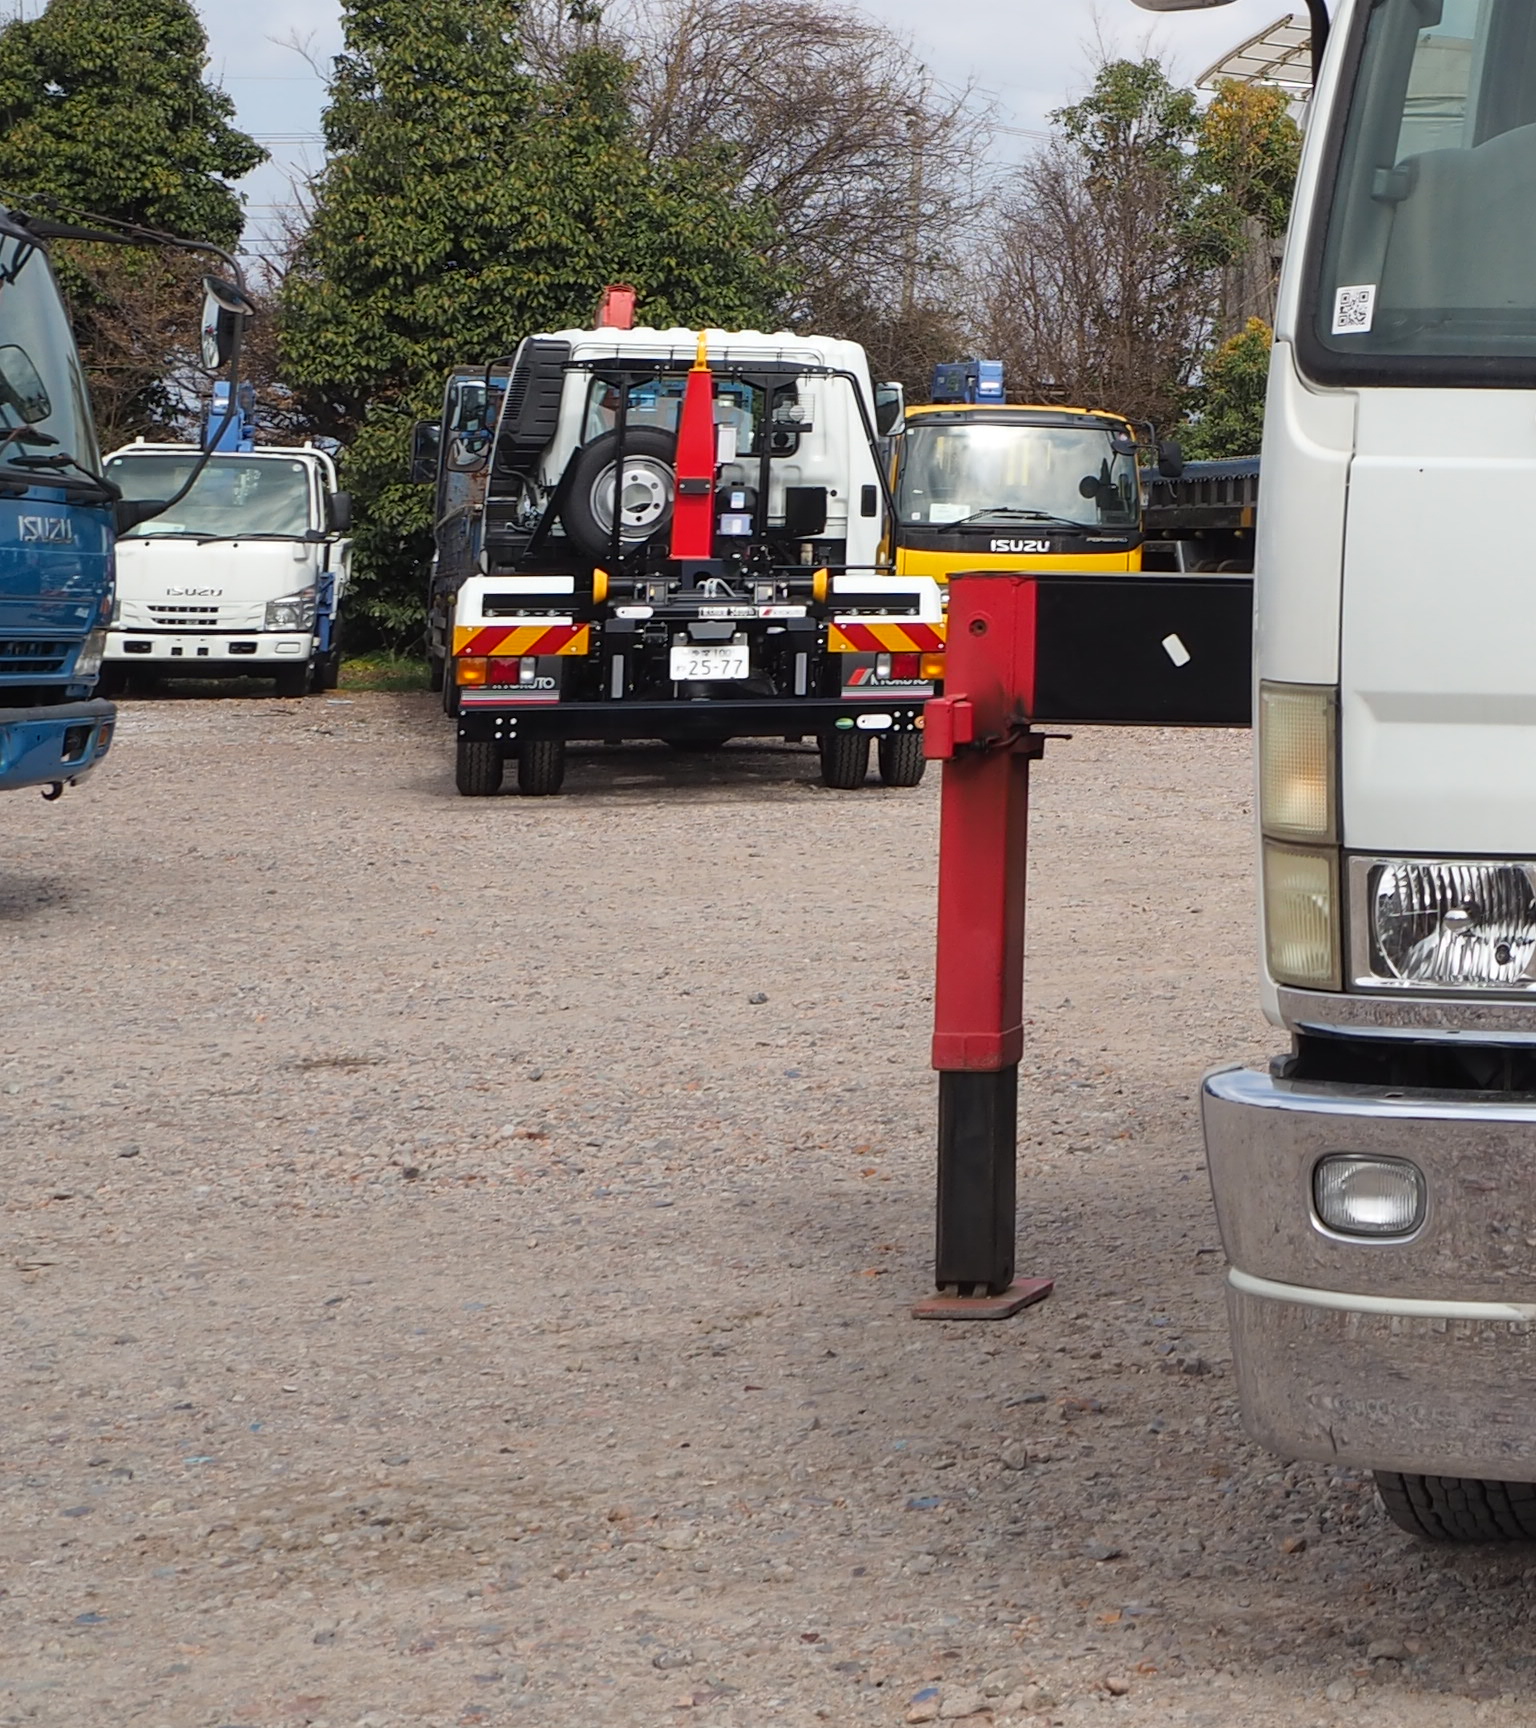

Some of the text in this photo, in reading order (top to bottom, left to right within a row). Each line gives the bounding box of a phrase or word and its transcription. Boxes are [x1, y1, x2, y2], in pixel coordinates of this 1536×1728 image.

[18, 515, 74, 543] ISUZU
[990, 539, 1050, 552] ISUZU
[166, 586, 223, 597] ISUZU
[688, 659, 743, 675] 25-77
